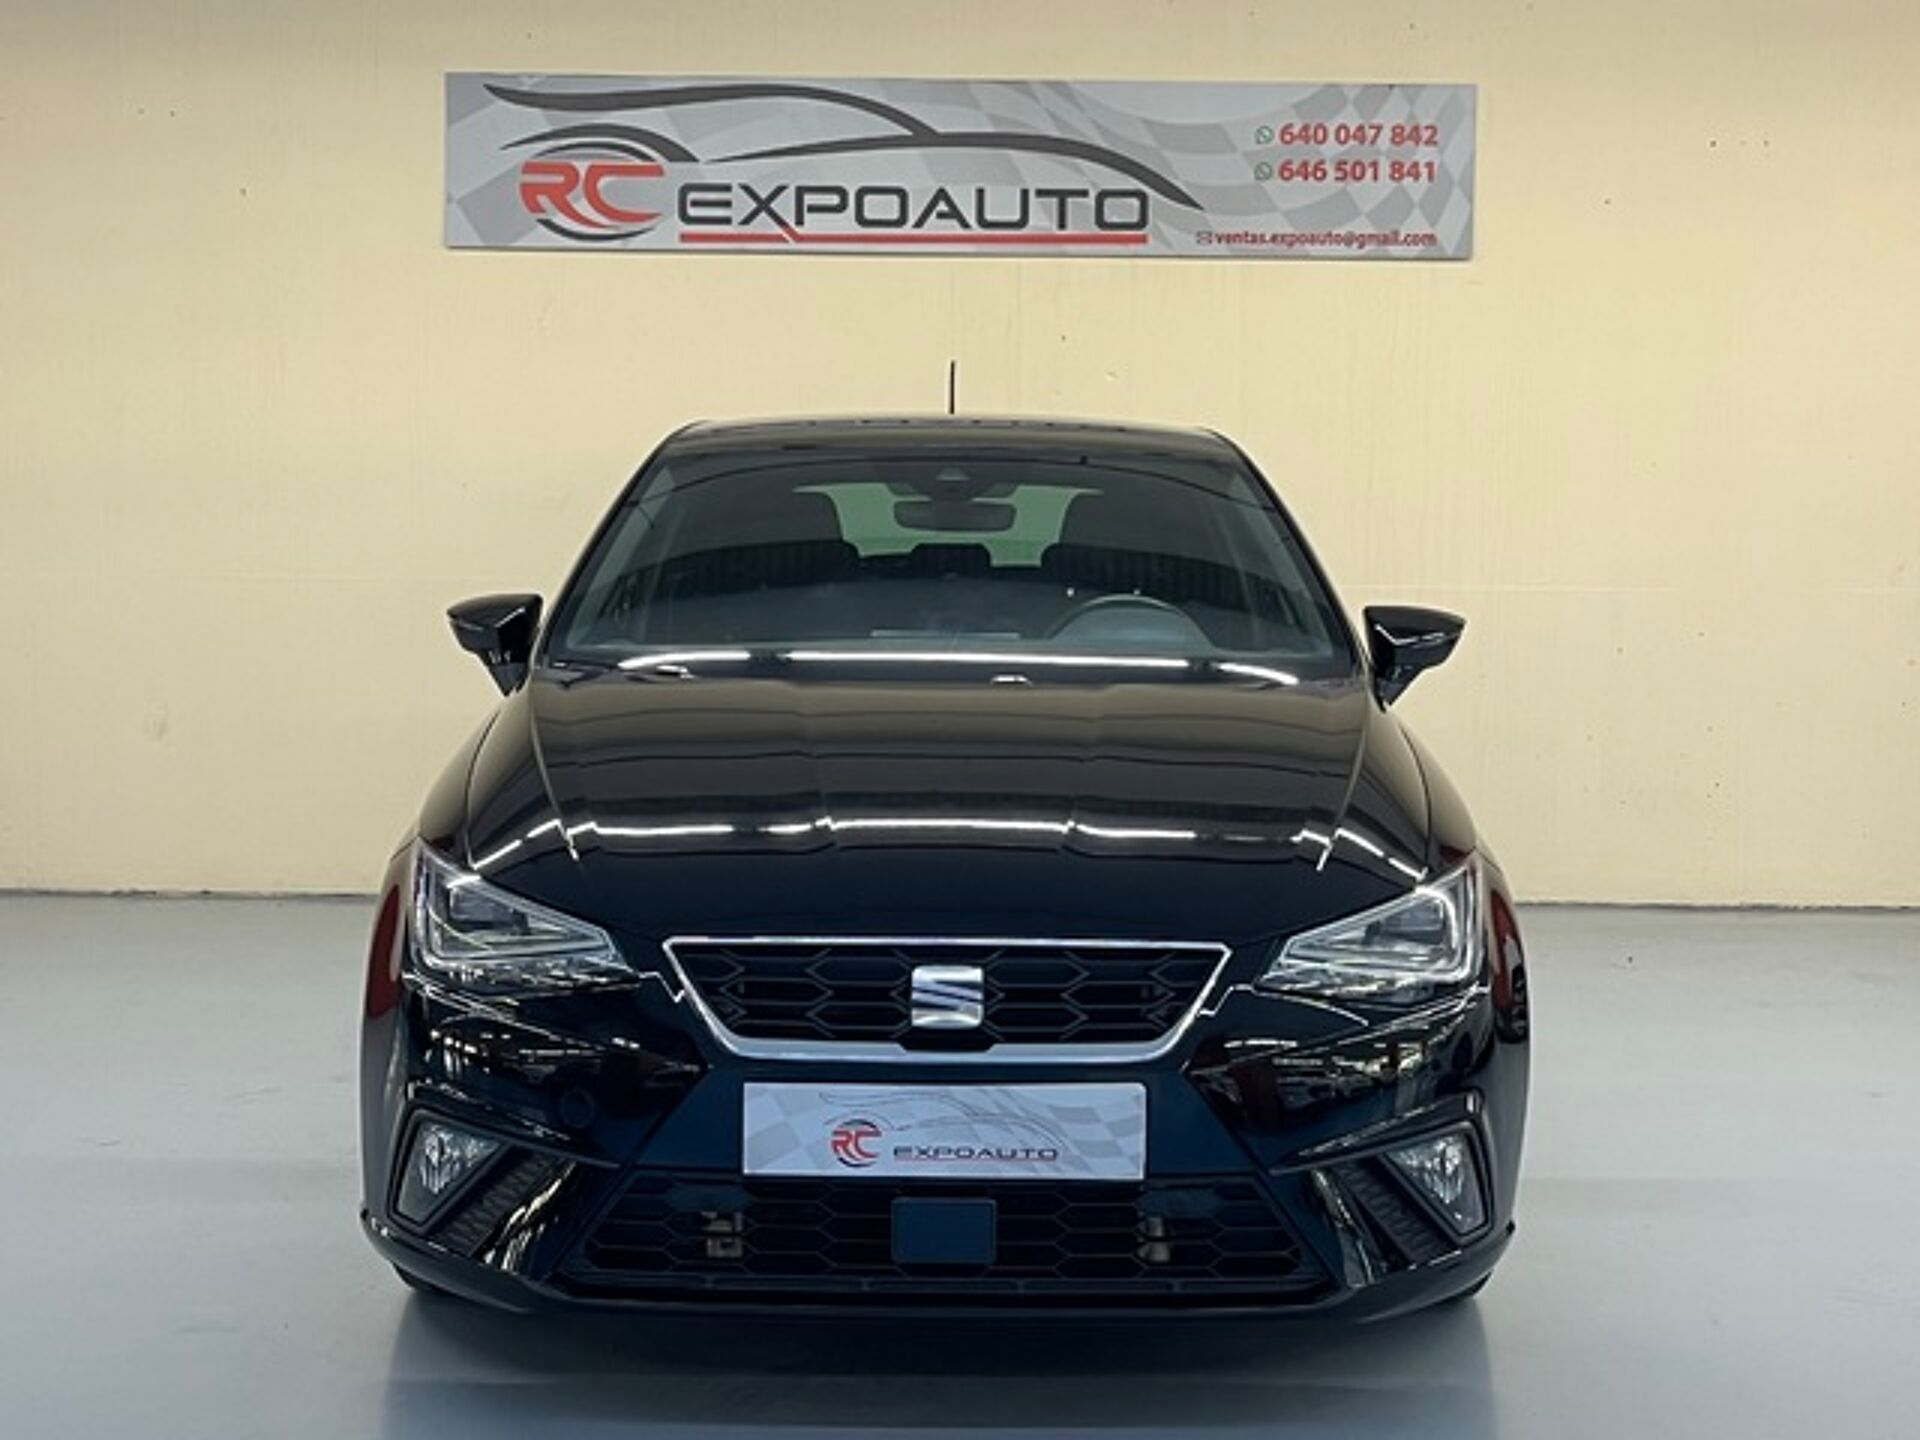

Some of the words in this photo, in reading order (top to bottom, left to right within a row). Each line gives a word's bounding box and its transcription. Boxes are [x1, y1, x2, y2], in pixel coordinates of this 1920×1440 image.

[1279, 123, 1328, 146] 640
[1334, 123, 1383, 146] 047
[1390, 123, 1439, 147] 842
[1278, 160, 1328, 182] 646
[1334, 160, 1381, 182] 501
[1388, 161, 1437, 183] 841
[519, 160, 665, 229] RC
[677, 182, 1150, 232] EXPOAUTO
[1213, 230, 1438, 249] ventas.expoauto@gmail.com
[830, 1130, 883, 1161] RC
[893, 1146, 1059, 1160] EXPOAUTO
